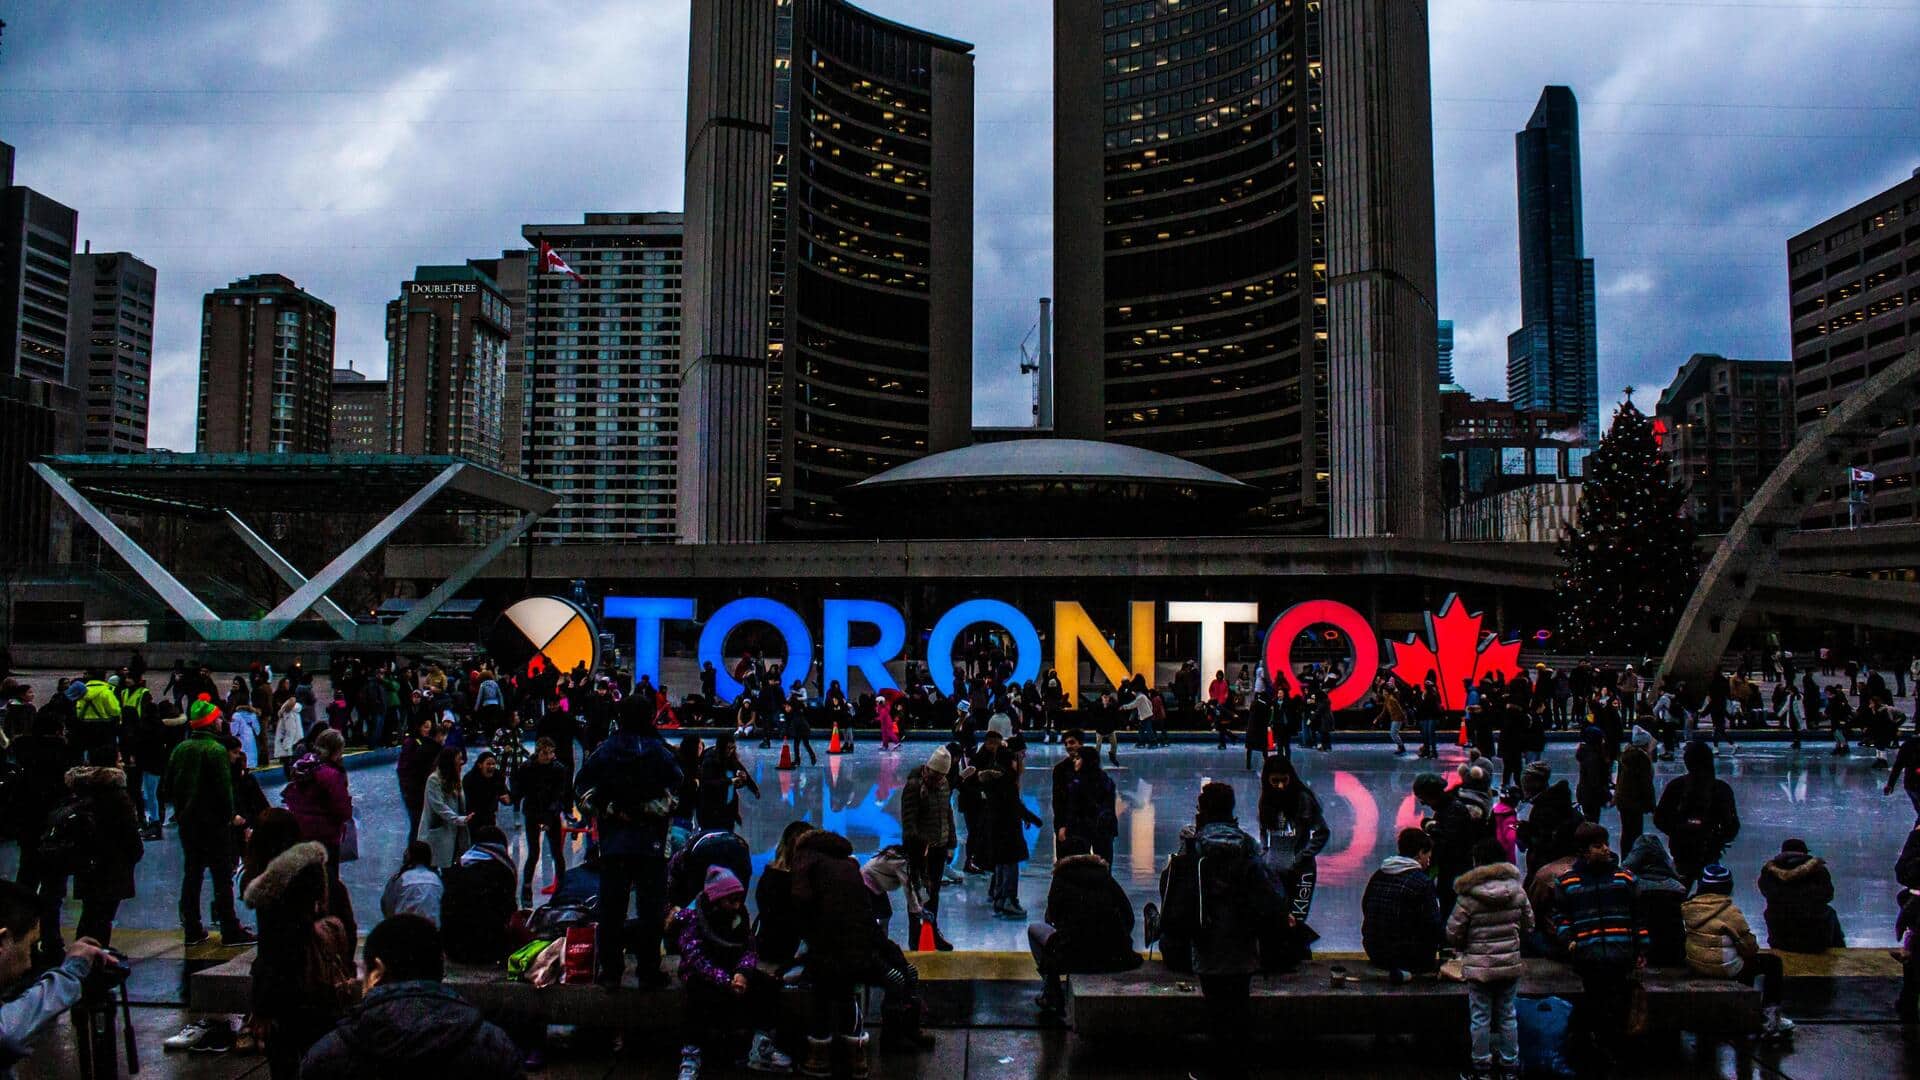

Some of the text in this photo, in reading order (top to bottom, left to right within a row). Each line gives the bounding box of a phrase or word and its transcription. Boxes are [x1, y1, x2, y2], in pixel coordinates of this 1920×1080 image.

[411, 283, 477, 293] DOUBLETREE
[603, 597, 1379, 711] TORONTO
[1292, 872, 1314, 915] Klein
